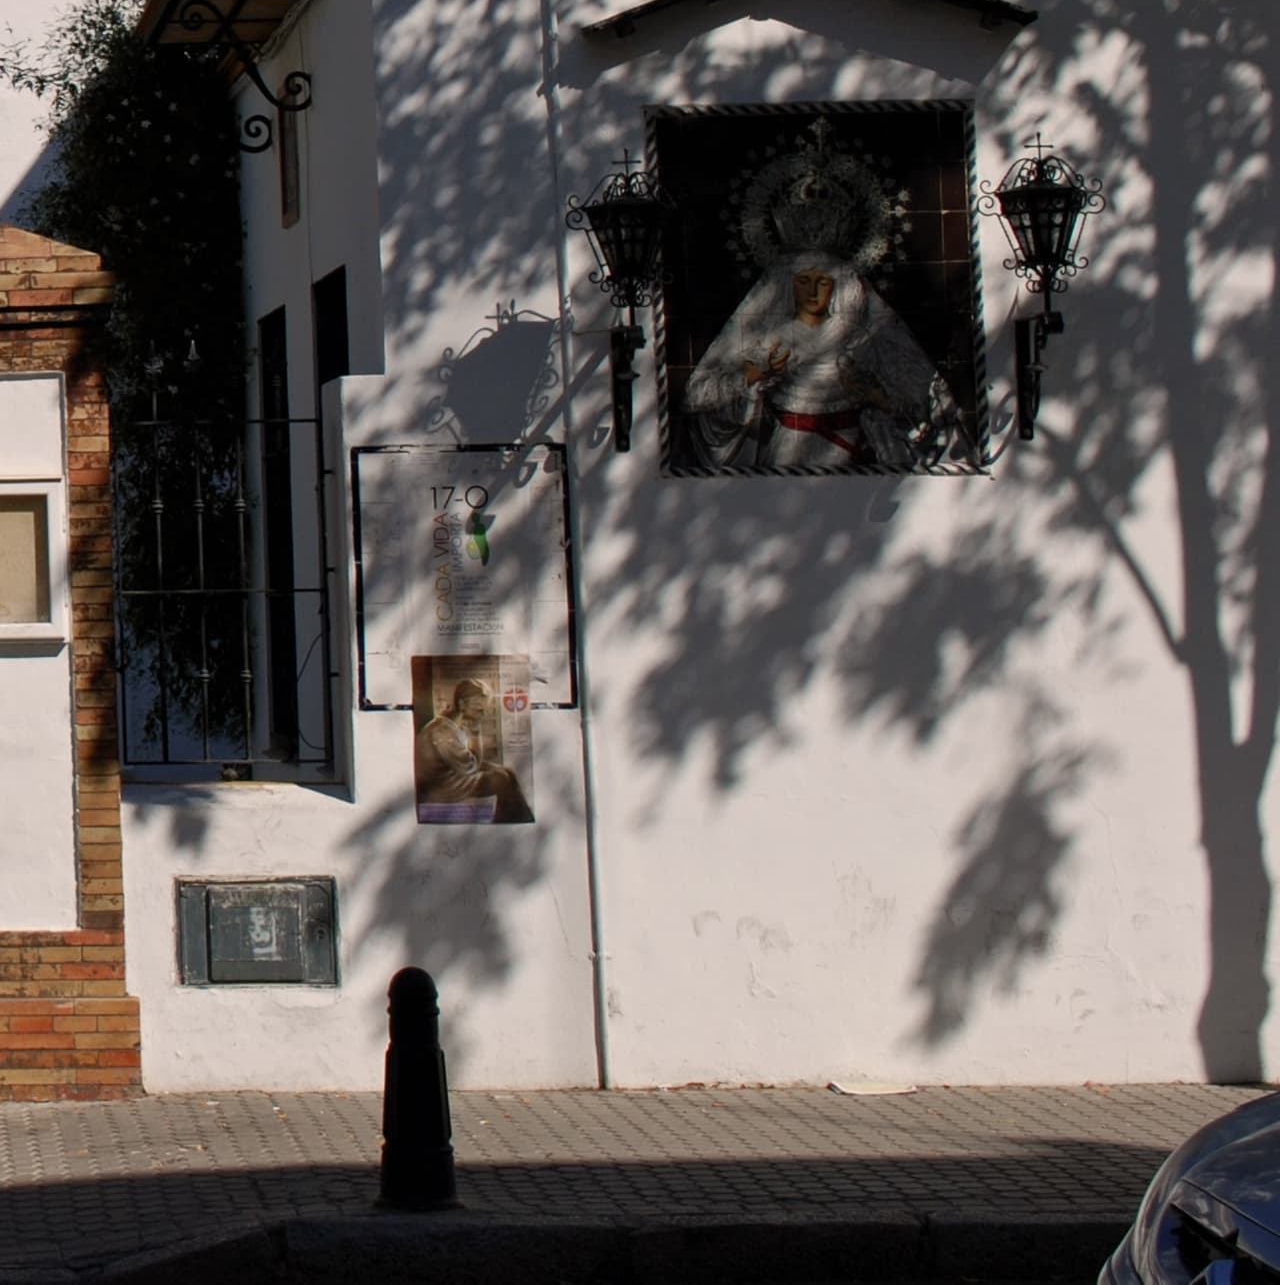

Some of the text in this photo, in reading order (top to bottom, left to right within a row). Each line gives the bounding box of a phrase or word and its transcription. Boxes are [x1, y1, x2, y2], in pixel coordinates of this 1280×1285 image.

[430, 485, 488, 509] 17-O
[433, 512, 453, 621] CADA VIDA
[450, 512, 462, 573] IMPORTA
